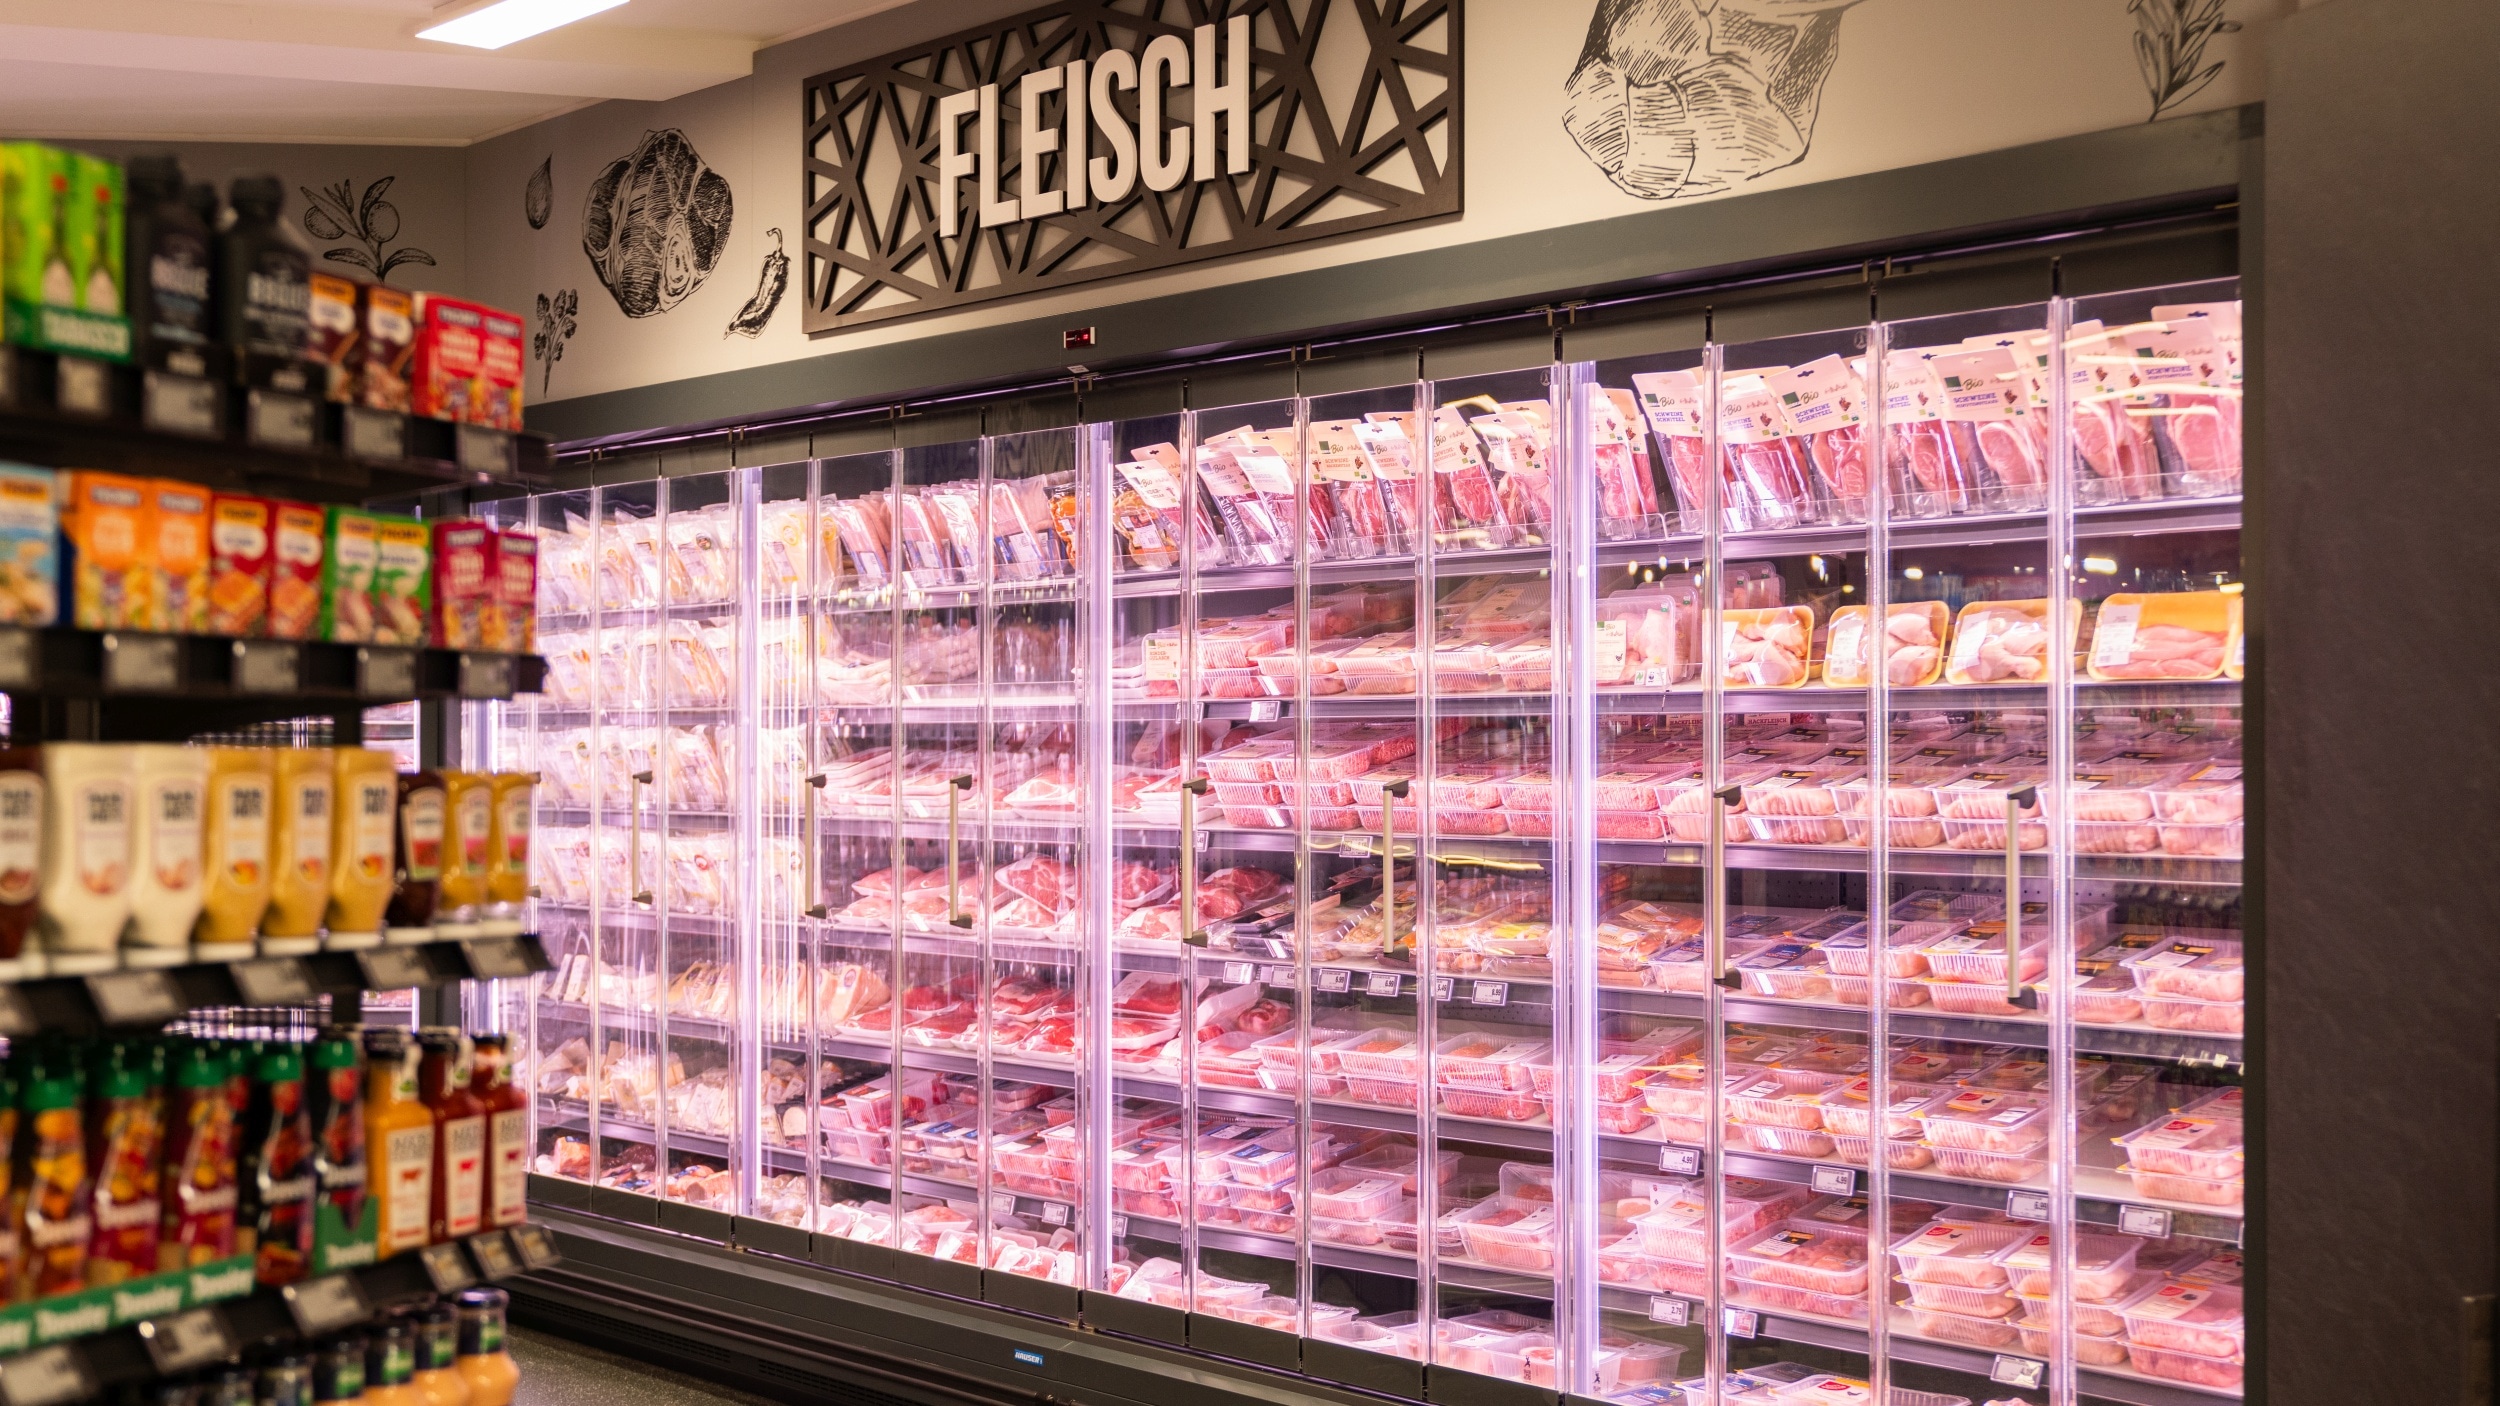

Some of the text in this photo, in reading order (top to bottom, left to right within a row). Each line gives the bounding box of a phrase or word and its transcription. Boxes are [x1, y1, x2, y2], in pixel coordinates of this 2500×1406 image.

[940, 14, 1250, 238] FLEISCH
[1963, 378, 1984, 391] Bio
[1660, 396, 1675, 408] Bio
[1801, 391, 1819, 404] Bio
[1953, 392, 1998, 404] SCHWEINE
[1725, 404, 1742, 416] Bio
[1795, 403, 1831, 418] SCHWEINE
[1797, 410, 1833, 423] SCHNITZEL
[1330, 443, 1344, 454] Bio
[1375, 444, 1388, 455] Bio
[1212, 463, 1226, 474] Bio
[1747, 717, 1787, 725] HACKFLEISCH
[1681, 1155, 1693, 1164] 4.99
[1835, 1176, 1848, 1185] 4.99
